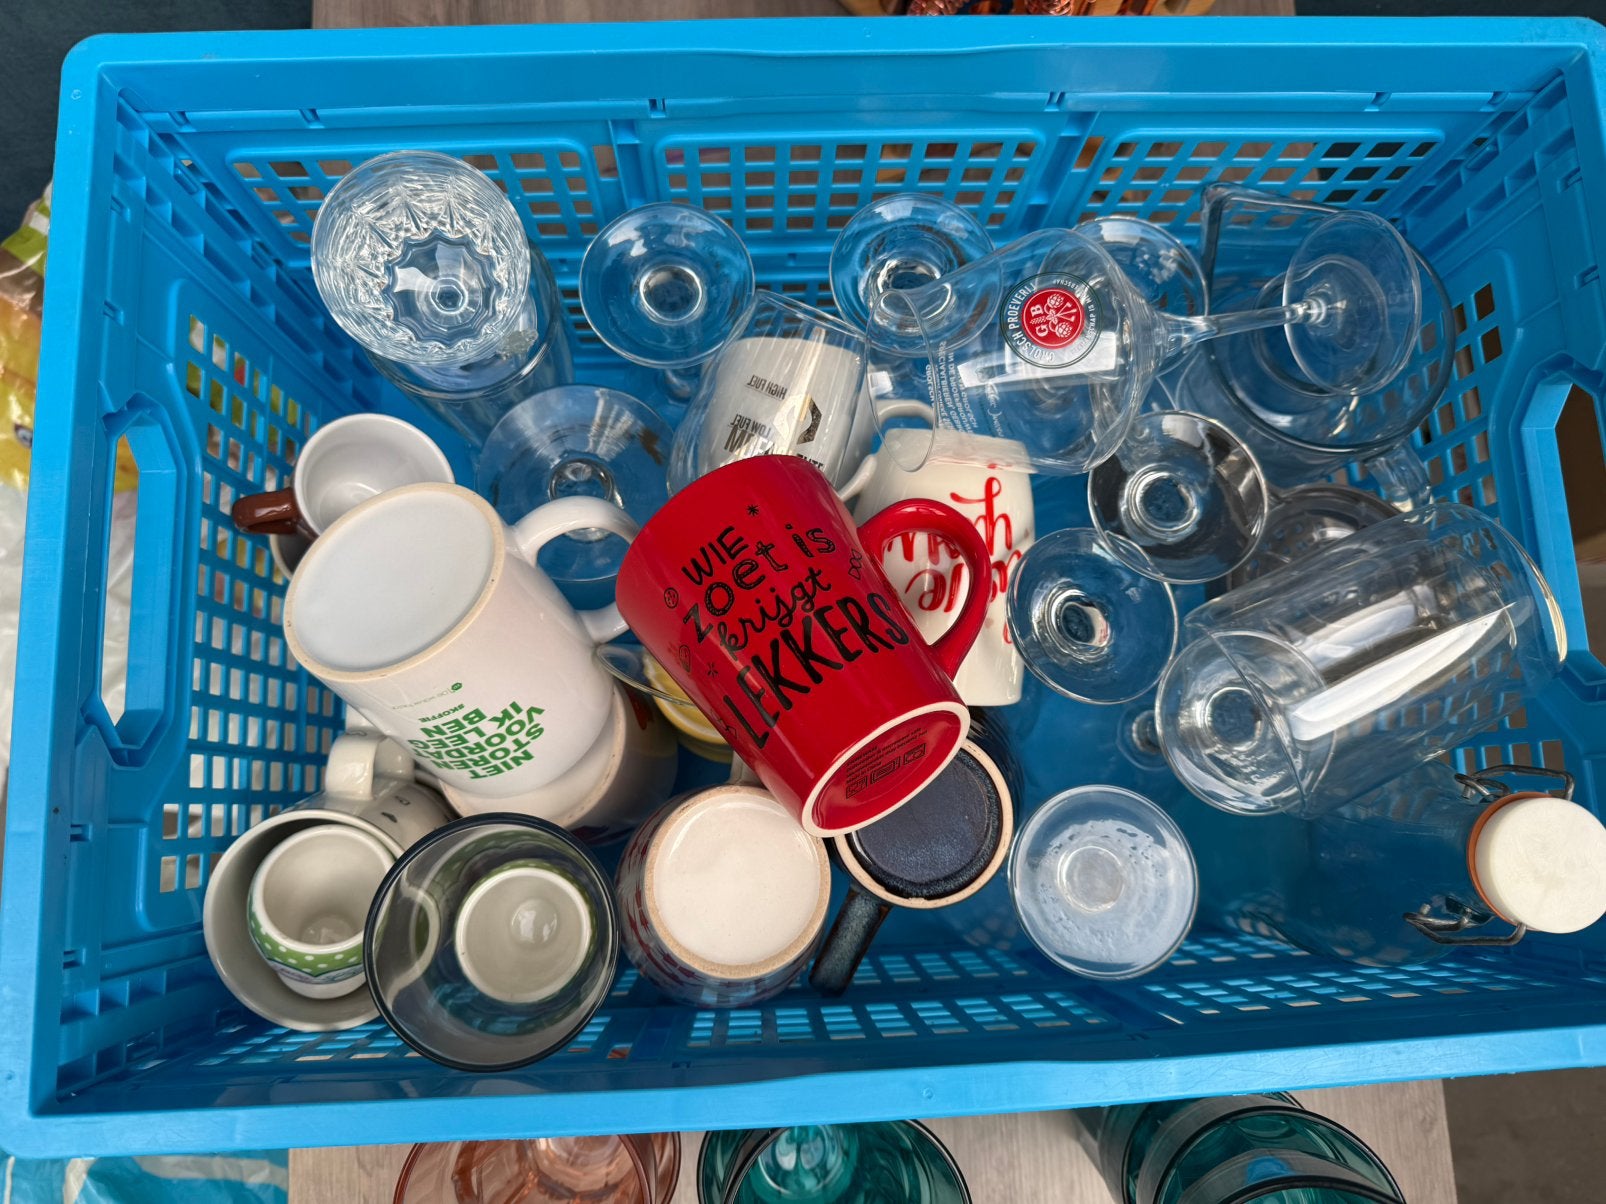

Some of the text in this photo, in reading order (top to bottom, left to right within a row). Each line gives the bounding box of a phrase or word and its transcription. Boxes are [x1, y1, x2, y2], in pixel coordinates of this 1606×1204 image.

[1007, 282, 1038, 330] PROEVERIJ
[1030, 304, 1049, 337] G B
[681, 526, 749, 586] WIE
[723, 591, 910, 749] LEKKERS
[407, 701, 523, 750] IK LEEG
[412, 706, 545, 760] VOORDAT
[420, 708, 487, 738] BEN
[430, 723, 545, 770] STOREN
[468, 749, 535, 779] NIET
